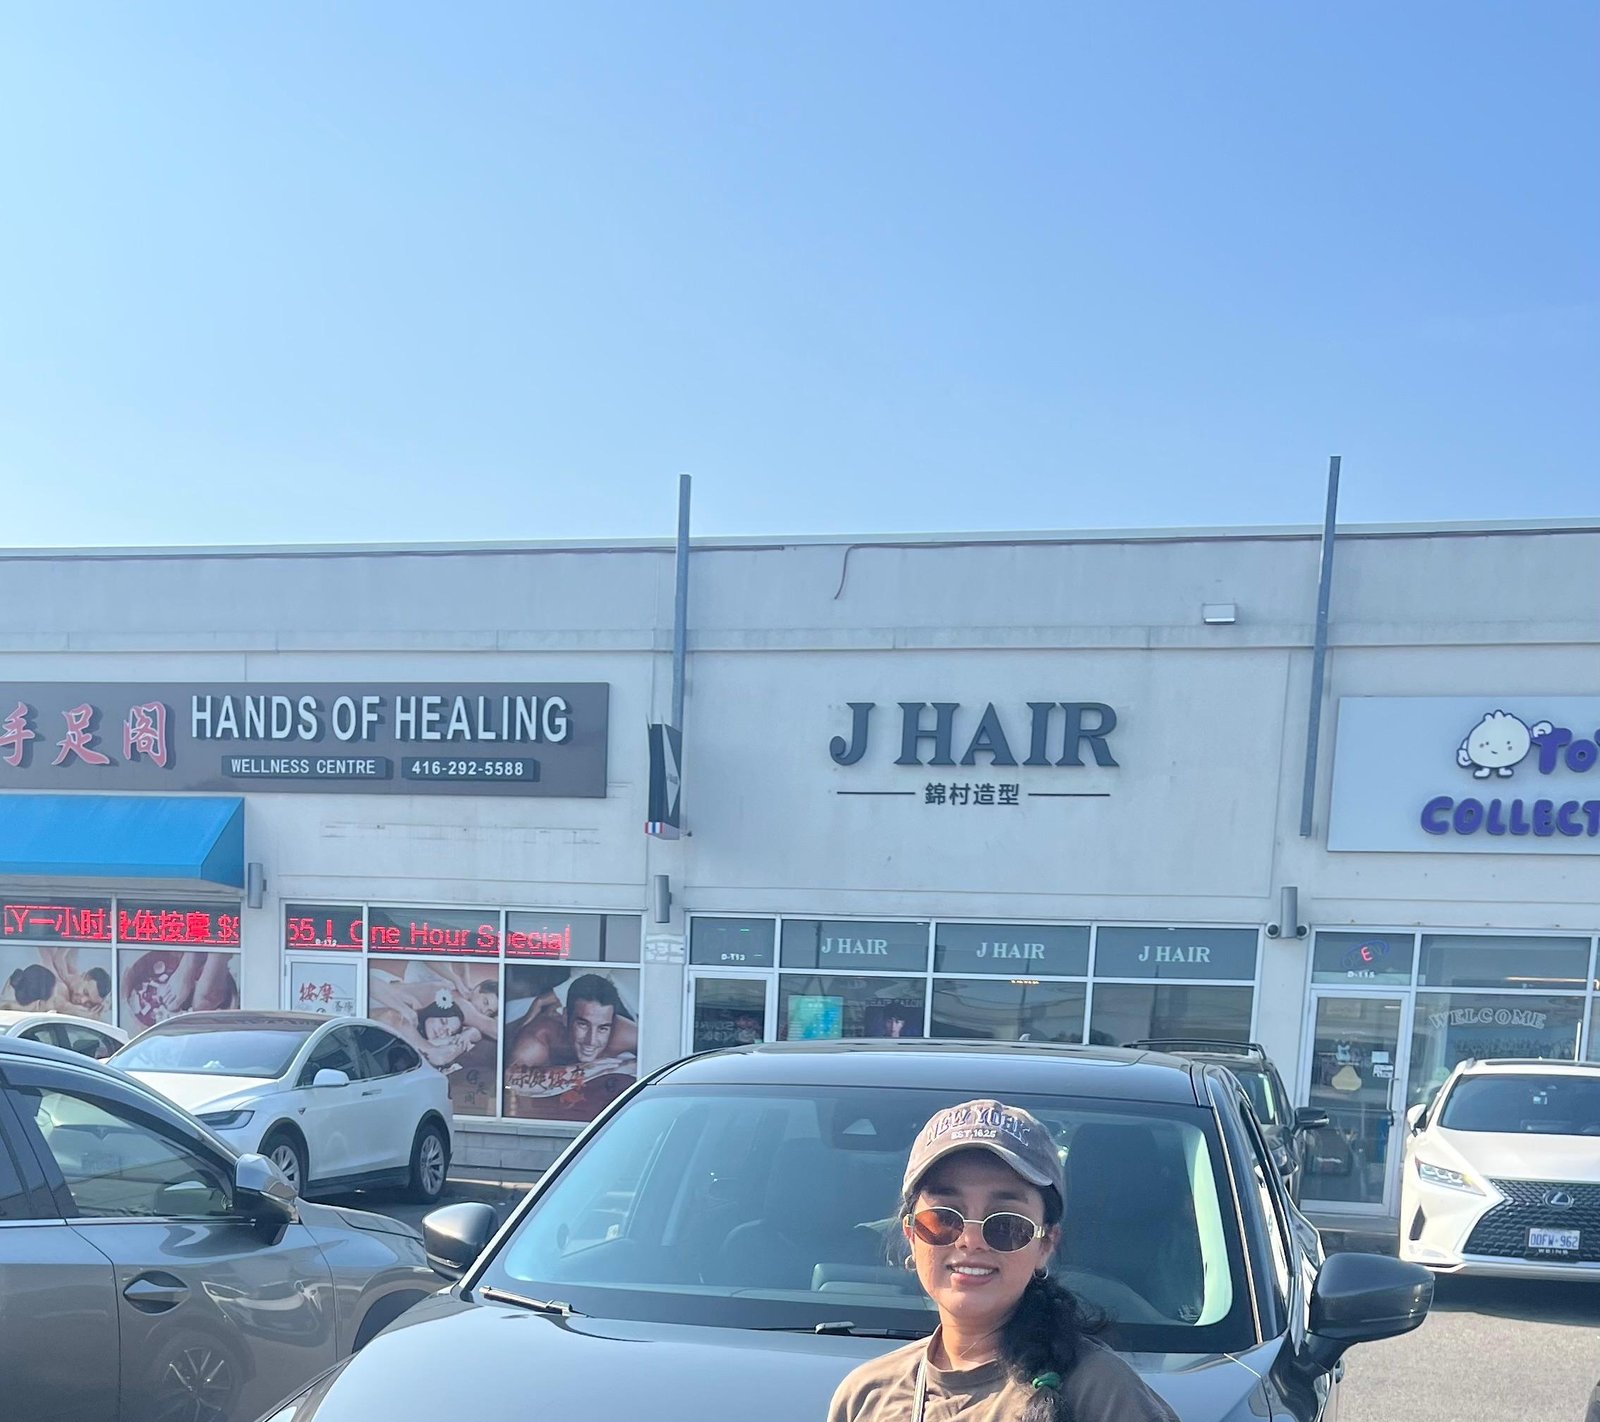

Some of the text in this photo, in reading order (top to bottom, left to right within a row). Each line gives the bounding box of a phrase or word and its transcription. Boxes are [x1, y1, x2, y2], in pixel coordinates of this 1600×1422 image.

[191, 694, 568, 743] HANDS OF HEALING
[829, 701, 1120, 768] J HAIR
[231, 759, 376, 775] WELLNESS CENTRE
[411, 761, 524, 776] 416-292-5588
[924, 782, 1020, 806] 錦村造型
[410, 922, 471, 946] Hour
[821, 938, 888, 956] J HAIR
[976, 942, 1045, 960] J HAIR
[1138, 945, 1211, 963] J HAIR
[1429, 1007, 1548, 1031] WELCOME
[927, 1105, 1030, 1147] NEW YORK
